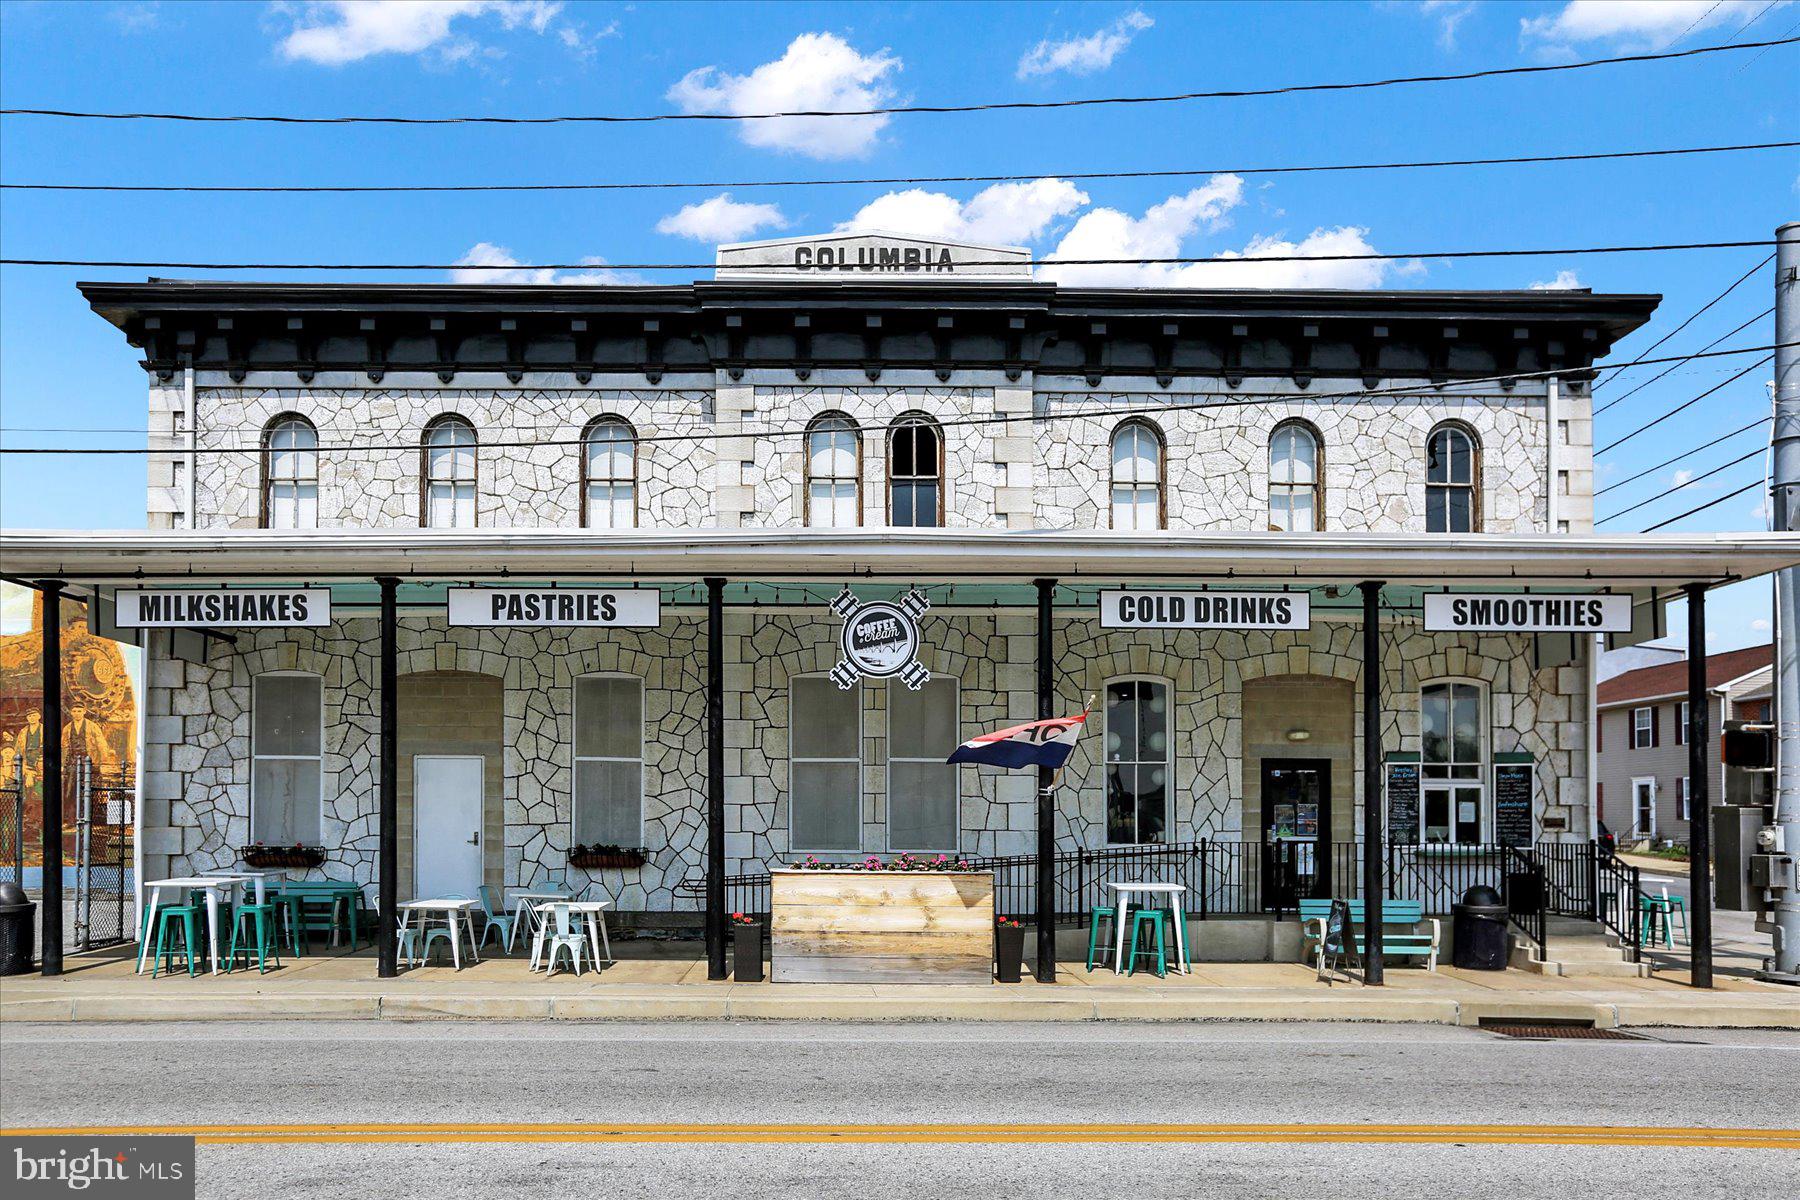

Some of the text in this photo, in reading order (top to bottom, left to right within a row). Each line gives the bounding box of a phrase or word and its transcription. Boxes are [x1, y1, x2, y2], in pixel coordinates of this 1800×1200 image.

[795, 247, 954, 272] COLUMBIA
[139, 594, 308, 622] MILKSHAKES
[491, 593, 617, 622] PASTRIES
[1119, 595, 1292, 625] COLD DRINKS
[1452, 599, 1603, 627] SMOOTHIES
[856, 617, 897, 637] COFFEE
[864, 628, 900, 643] cream
